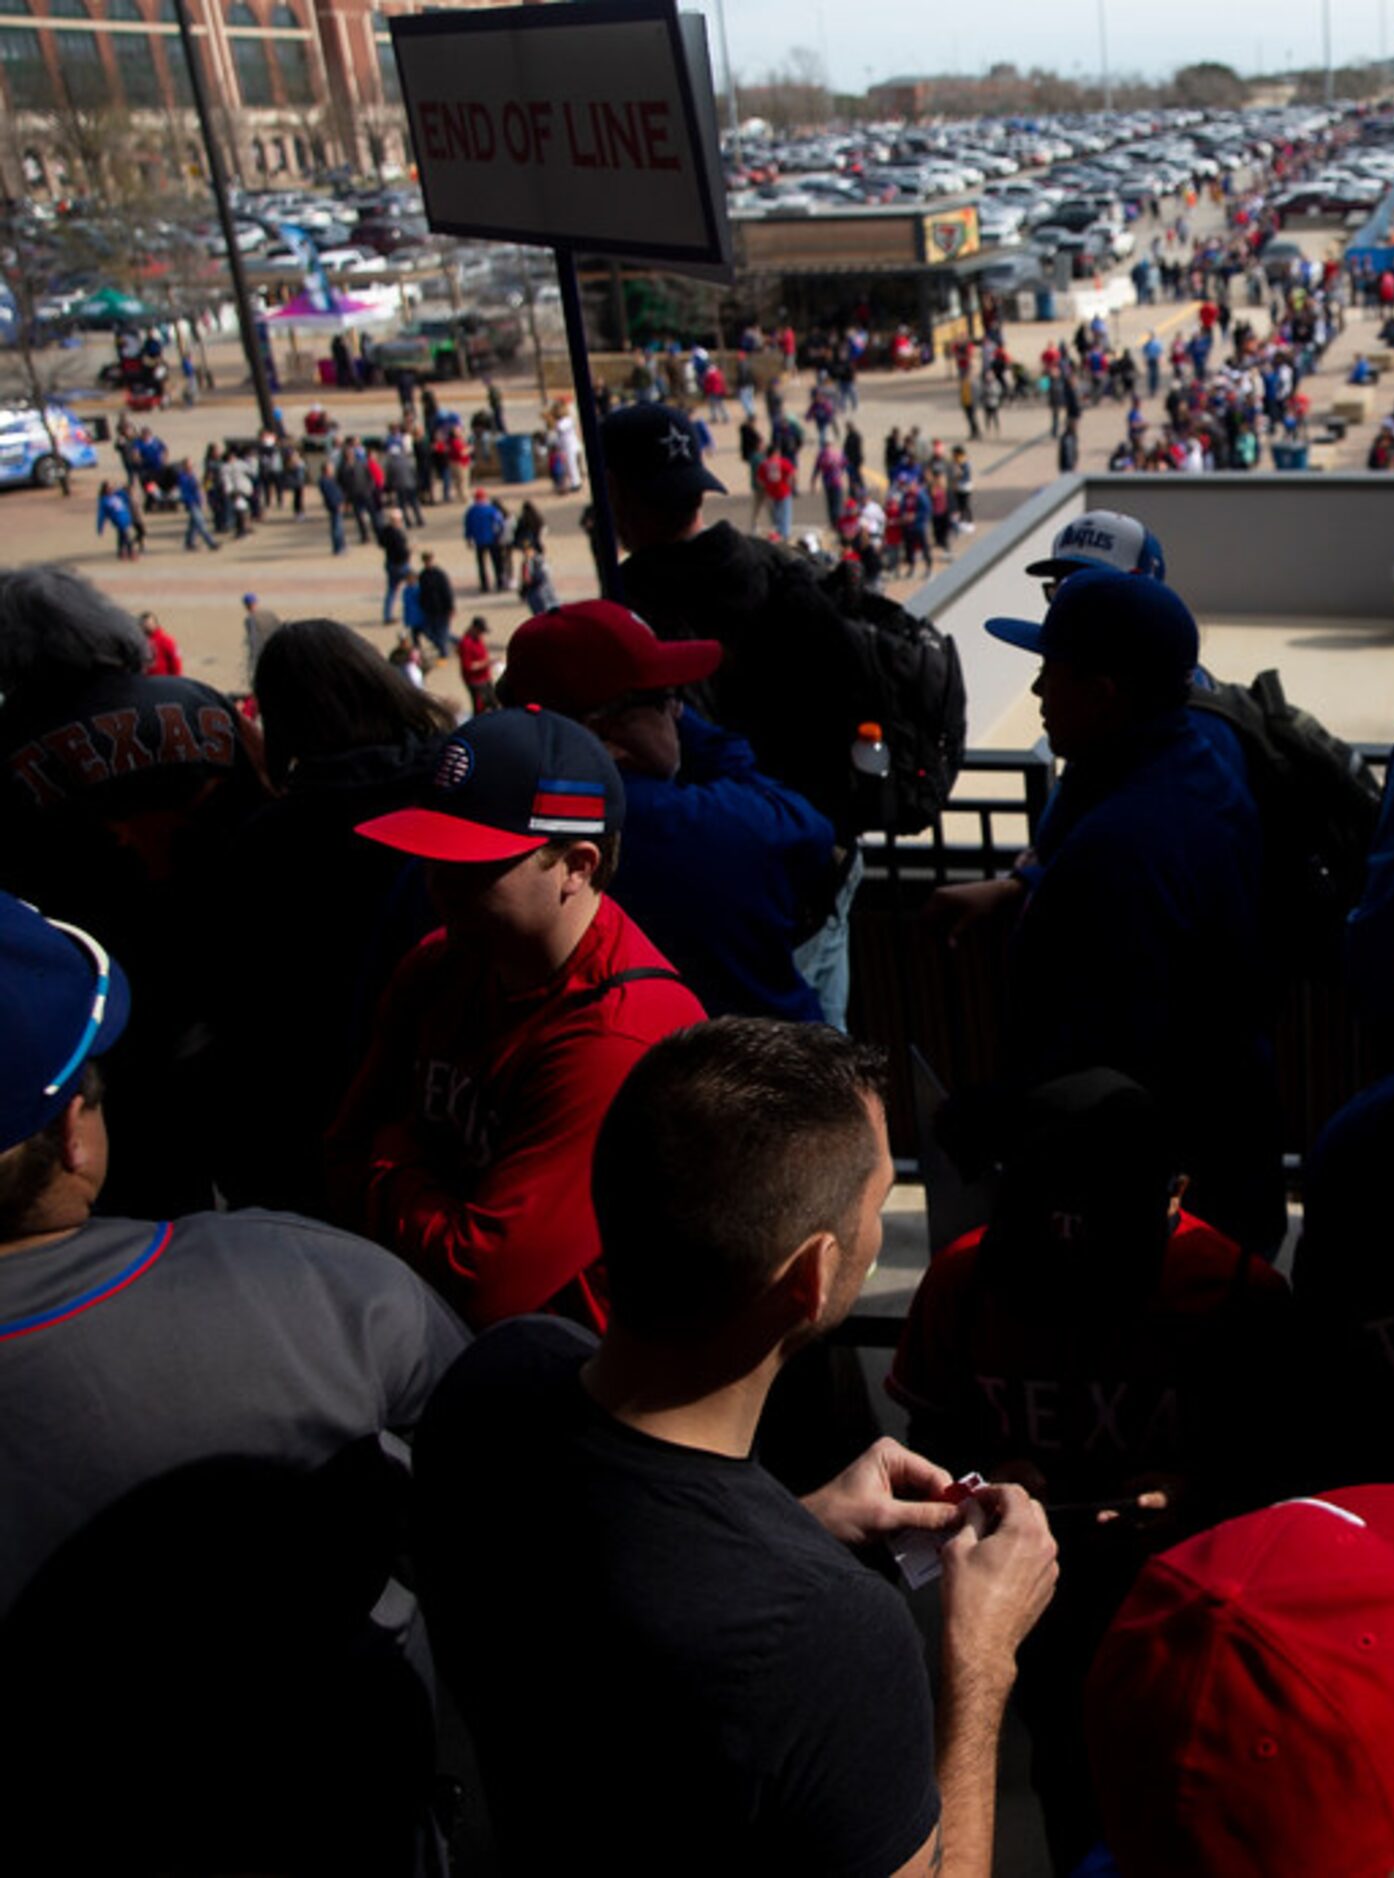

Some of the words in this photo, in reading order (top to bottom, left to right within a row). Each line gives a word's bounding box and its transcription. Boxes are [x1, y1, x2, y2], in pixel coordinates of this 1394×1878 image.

[418, 101, 496, 161] END
[503, 101, 552, 164] OF
[563, 101, 681, 171] LINE
[6, 703, 235, 809] TEXAS
